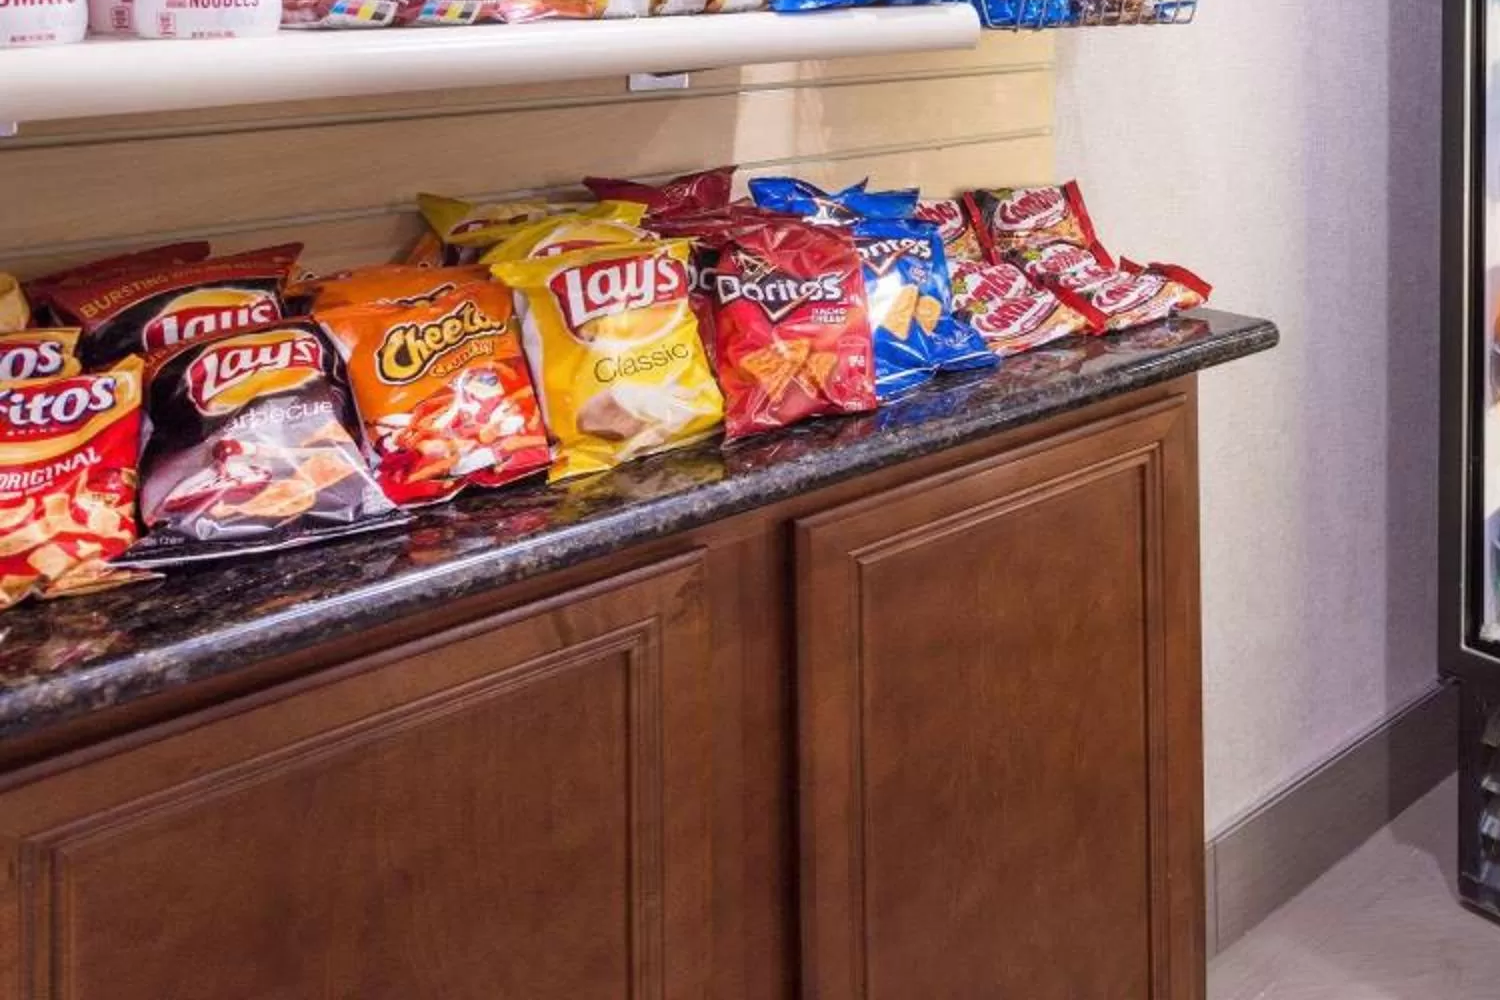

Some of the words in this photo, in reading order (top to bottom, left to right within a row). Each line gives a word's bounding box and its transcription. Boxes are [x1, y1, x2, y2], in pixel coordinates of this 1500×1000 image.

[564, 252, 680, 327] Lay's
[717, 270, 843, 305] Doritos
[200, 336, 316, 402] Lay's
[593, 340, 690, 384] Classic
[0, 374, 116, 427] itos
